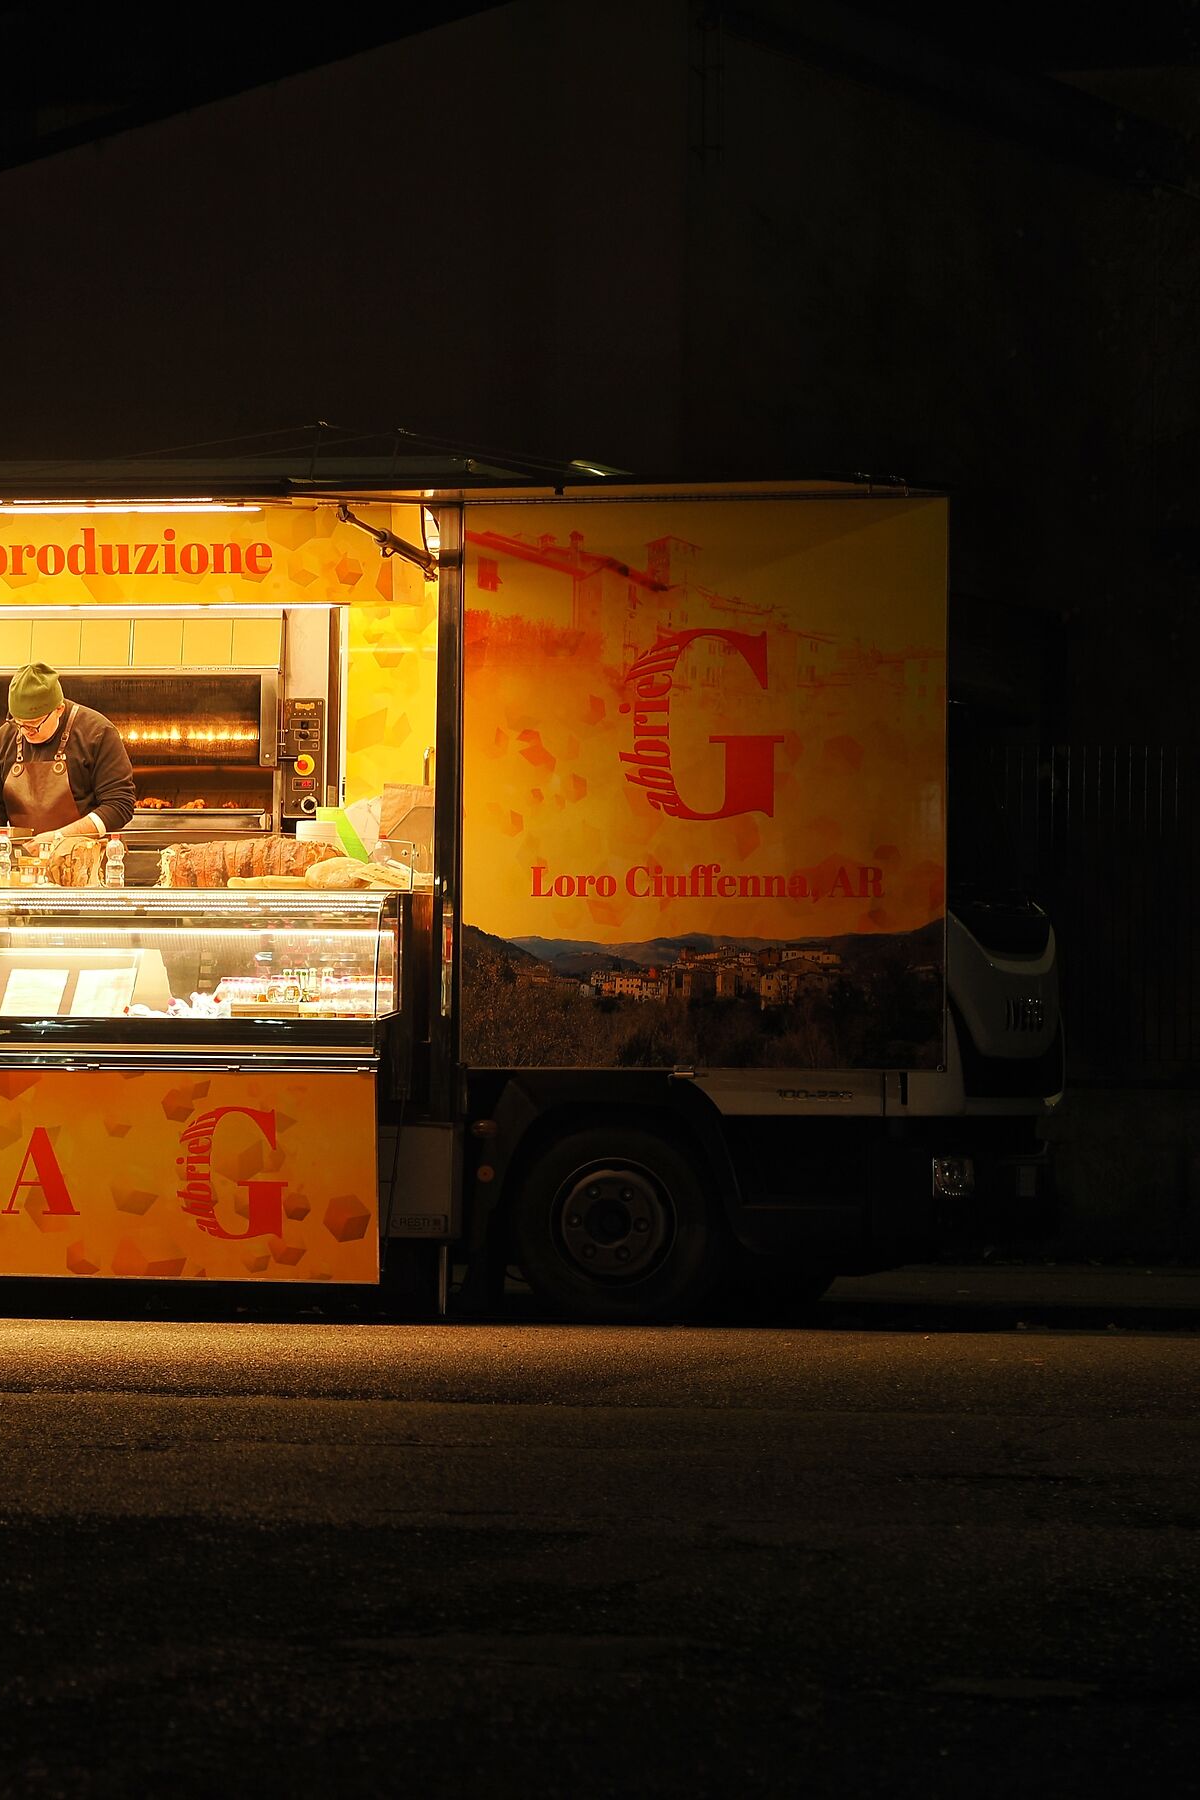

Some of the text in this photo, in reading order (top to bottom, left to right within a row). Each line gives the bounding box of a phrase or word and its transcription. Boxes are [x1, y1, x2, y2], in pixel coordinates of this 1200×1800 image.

[530, 863, 885, 903] Loro Ciuffenna, AR
